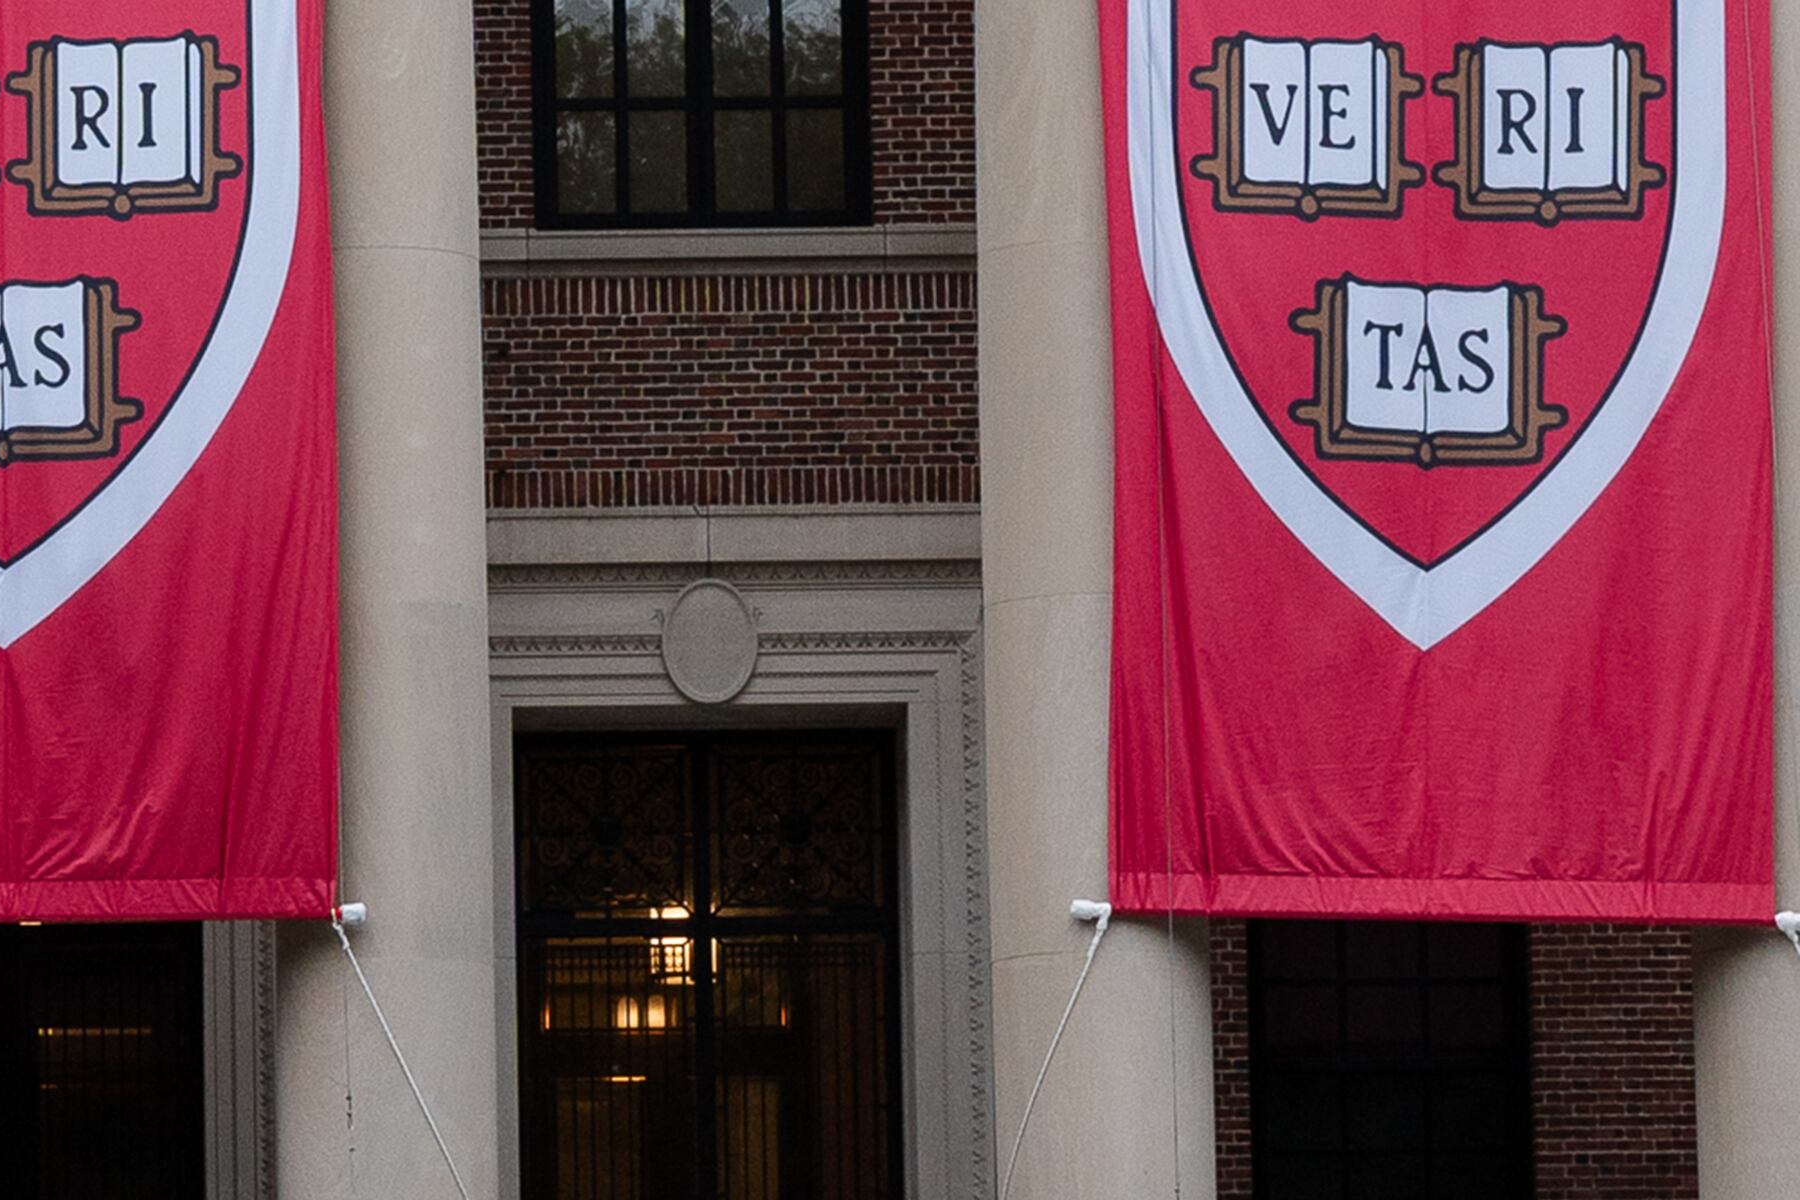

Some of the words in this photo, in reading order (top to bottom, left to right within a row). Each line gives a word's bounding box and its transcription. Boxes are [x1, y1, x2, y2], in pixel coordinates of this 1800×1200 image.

[69, 82, 158, 151] RI
[1248, 83, 1356, 151] VE
[1495, 87, 1586, 156] RI
[1363, 320, 1496, 394] TAS
